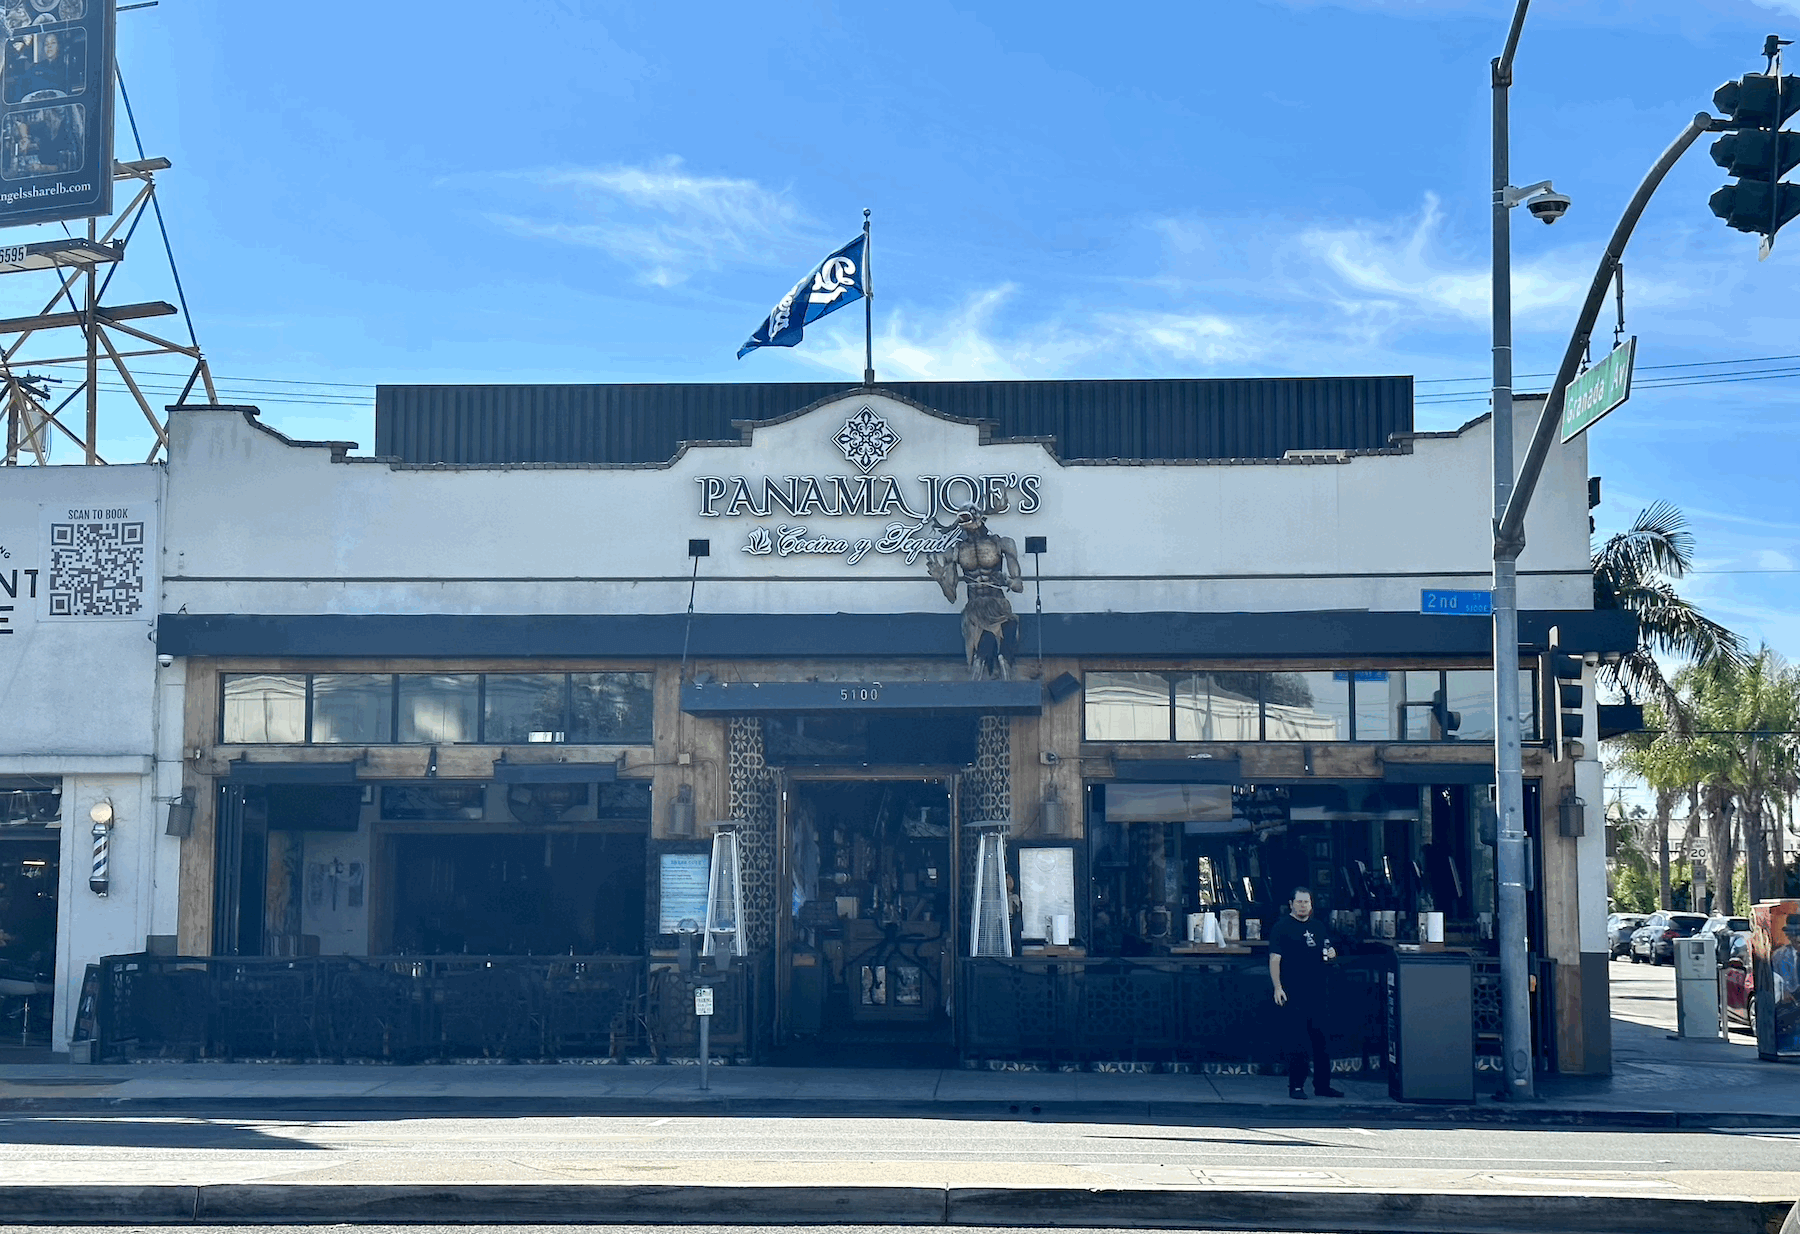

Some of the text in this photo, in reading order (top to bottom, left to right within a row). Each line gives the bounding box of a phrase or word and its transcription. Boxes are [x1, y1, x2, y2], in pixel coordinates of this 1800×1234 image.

[0, 182, 91, 204] ngelssharelb.com
[694, 472, 1042, 523] PANAMA JOE'S
[68, 508, 128, 520] SCAN TO BOOK
[777, 522, 963, 565] Cocina y Tequil
[1427, 593, 1458, 609] 2nd
[840, 688, 879, 701] 5100
[1690, 848, 1706, 858] 20
